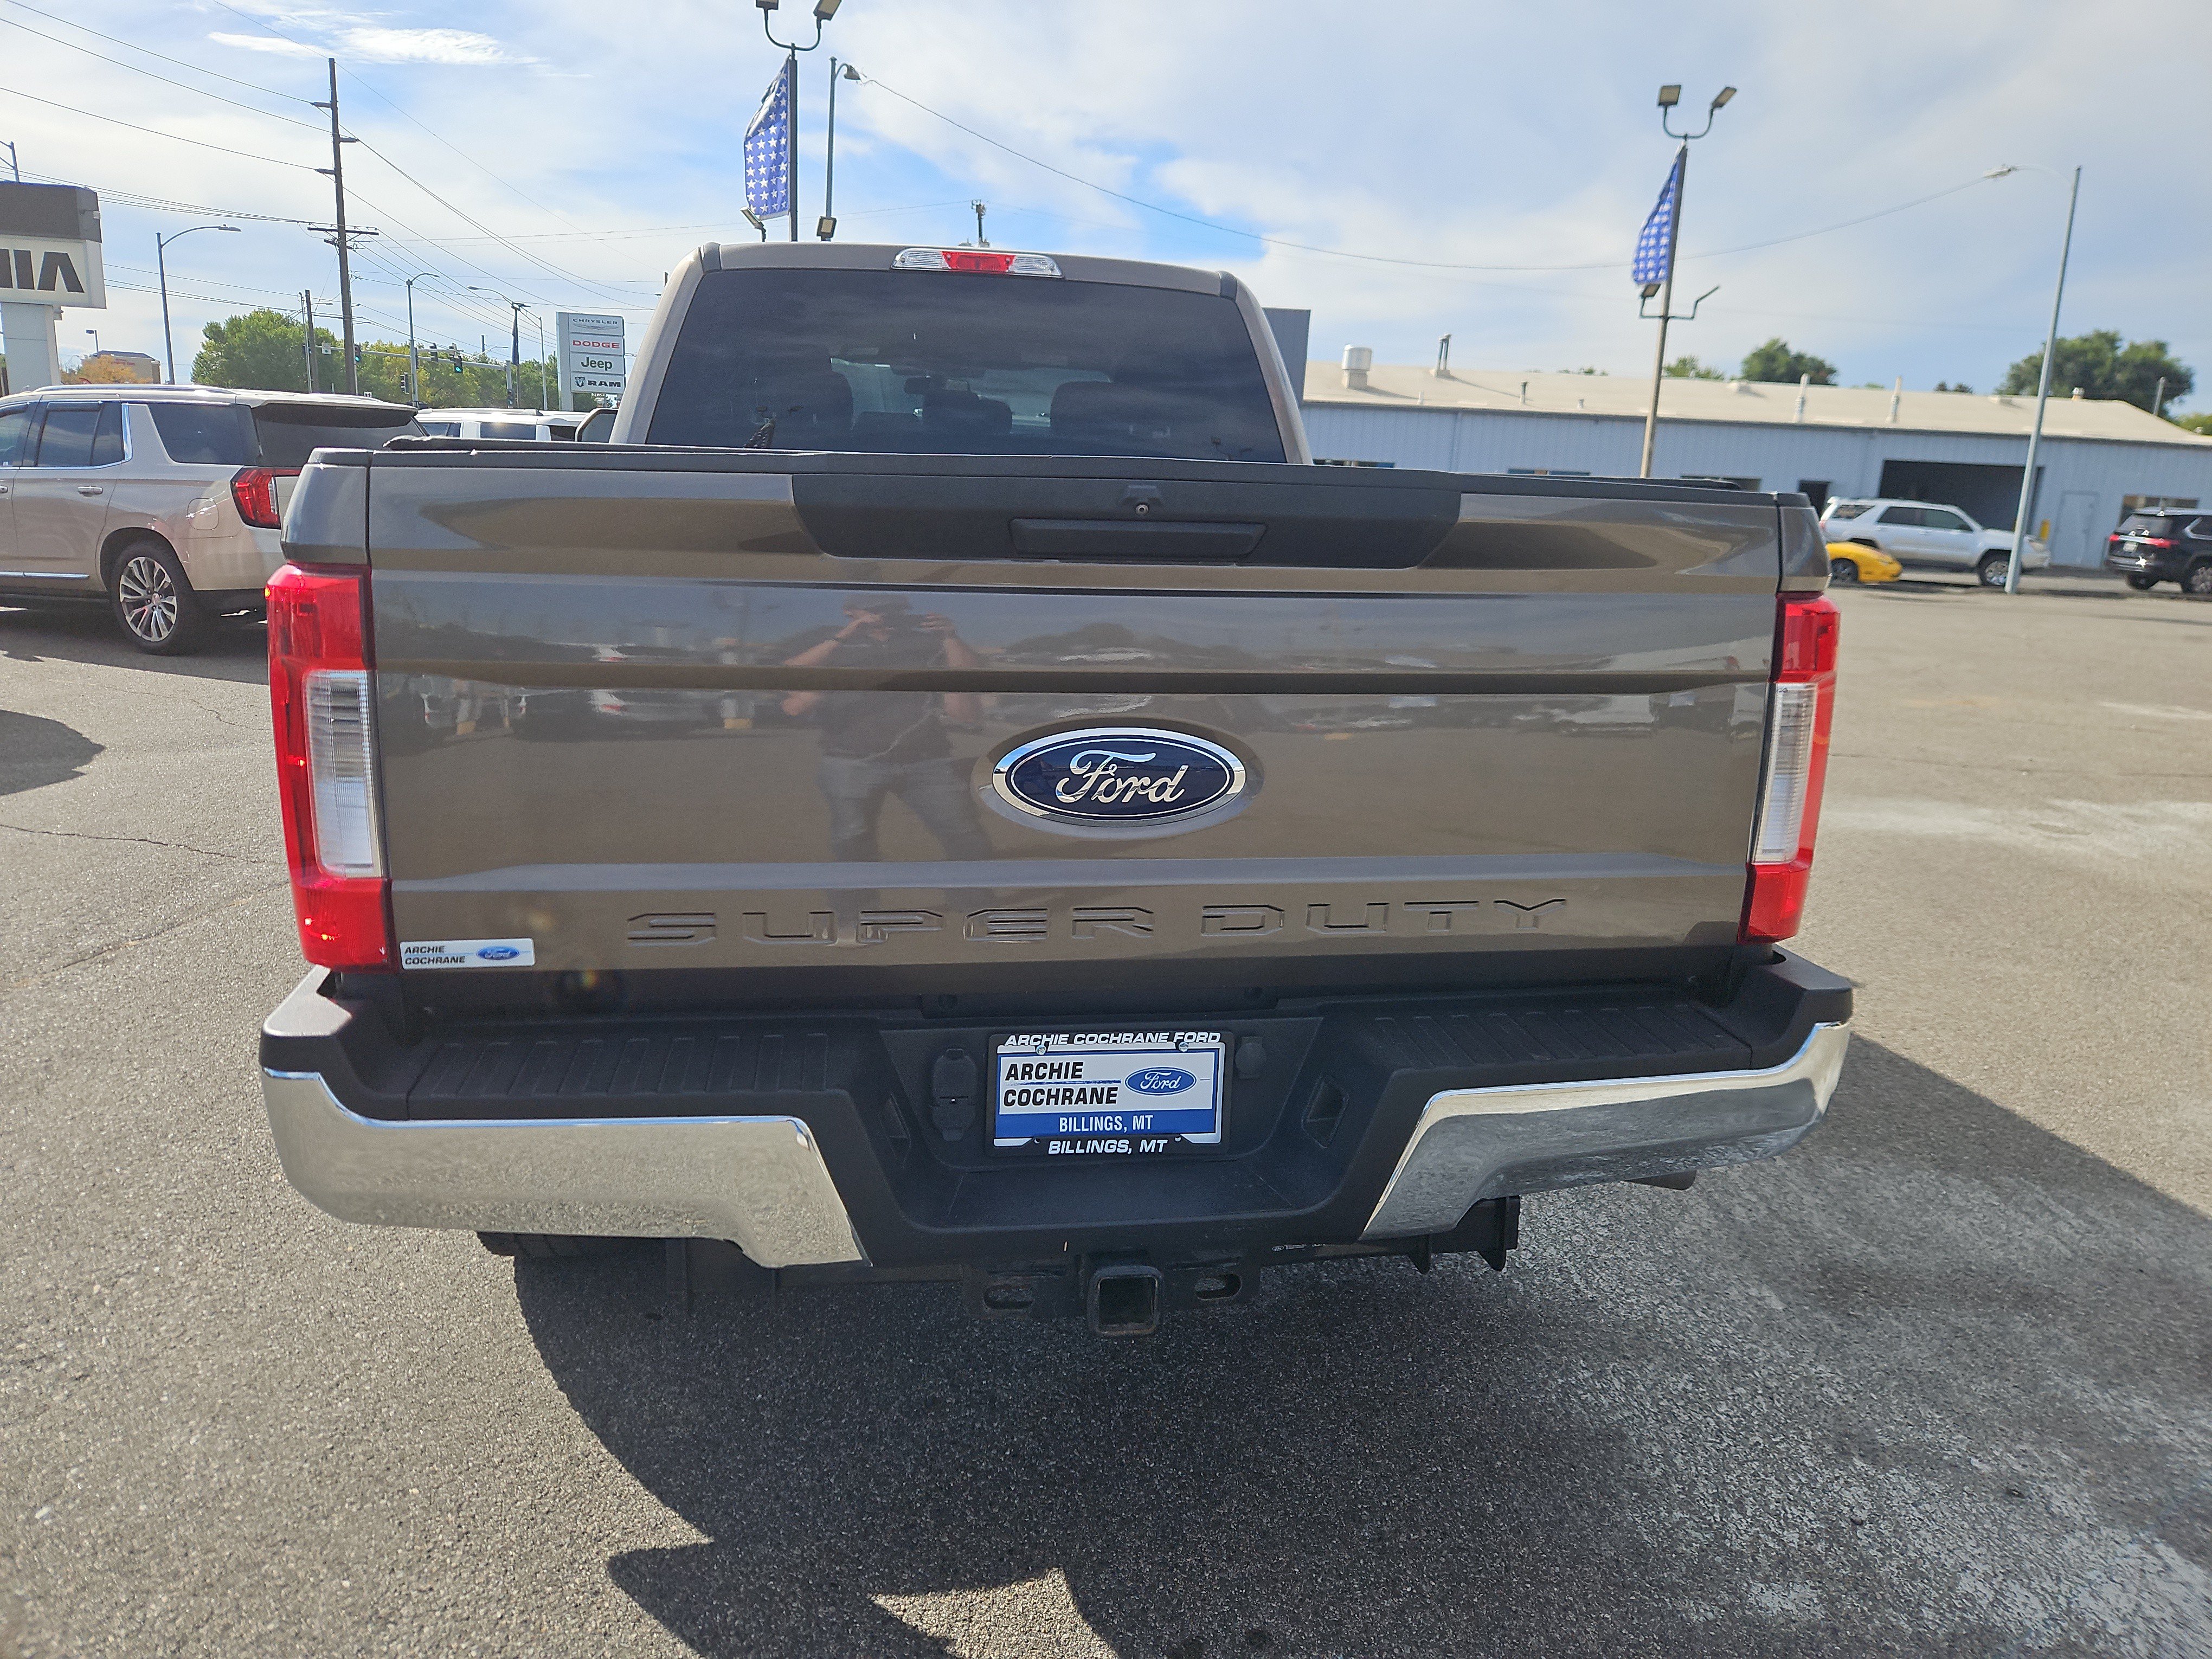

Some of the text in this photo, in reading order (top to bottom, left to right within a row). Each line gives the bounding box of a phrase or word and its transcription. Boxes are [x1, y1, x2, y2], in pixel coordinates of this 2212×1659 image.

[573, 340, 620, 349] DODGE
[581, 357, 613, 371] Jeep
[1056, 750, 1189, 803] Ford
[627, 898, 1567, 947] SUPER DUTY
[404, 945, 445, 954] ARCHIE
[404, 956, 466, 964] COCHRANE
[1004, 1032, 1221, 1046] ARCHIE COCHRANE FORD
[1005, 1061, 1084, 1081] ARCHIE
[1140, 1071, 1181, 1090] Ford
[1004, 1086, 1118, 1107] COCHRANE
[1059, 1115, 1154, 1133] BILLINGS, MT
[1048, 1140, 1168, 1154] BILLINGS, MT
